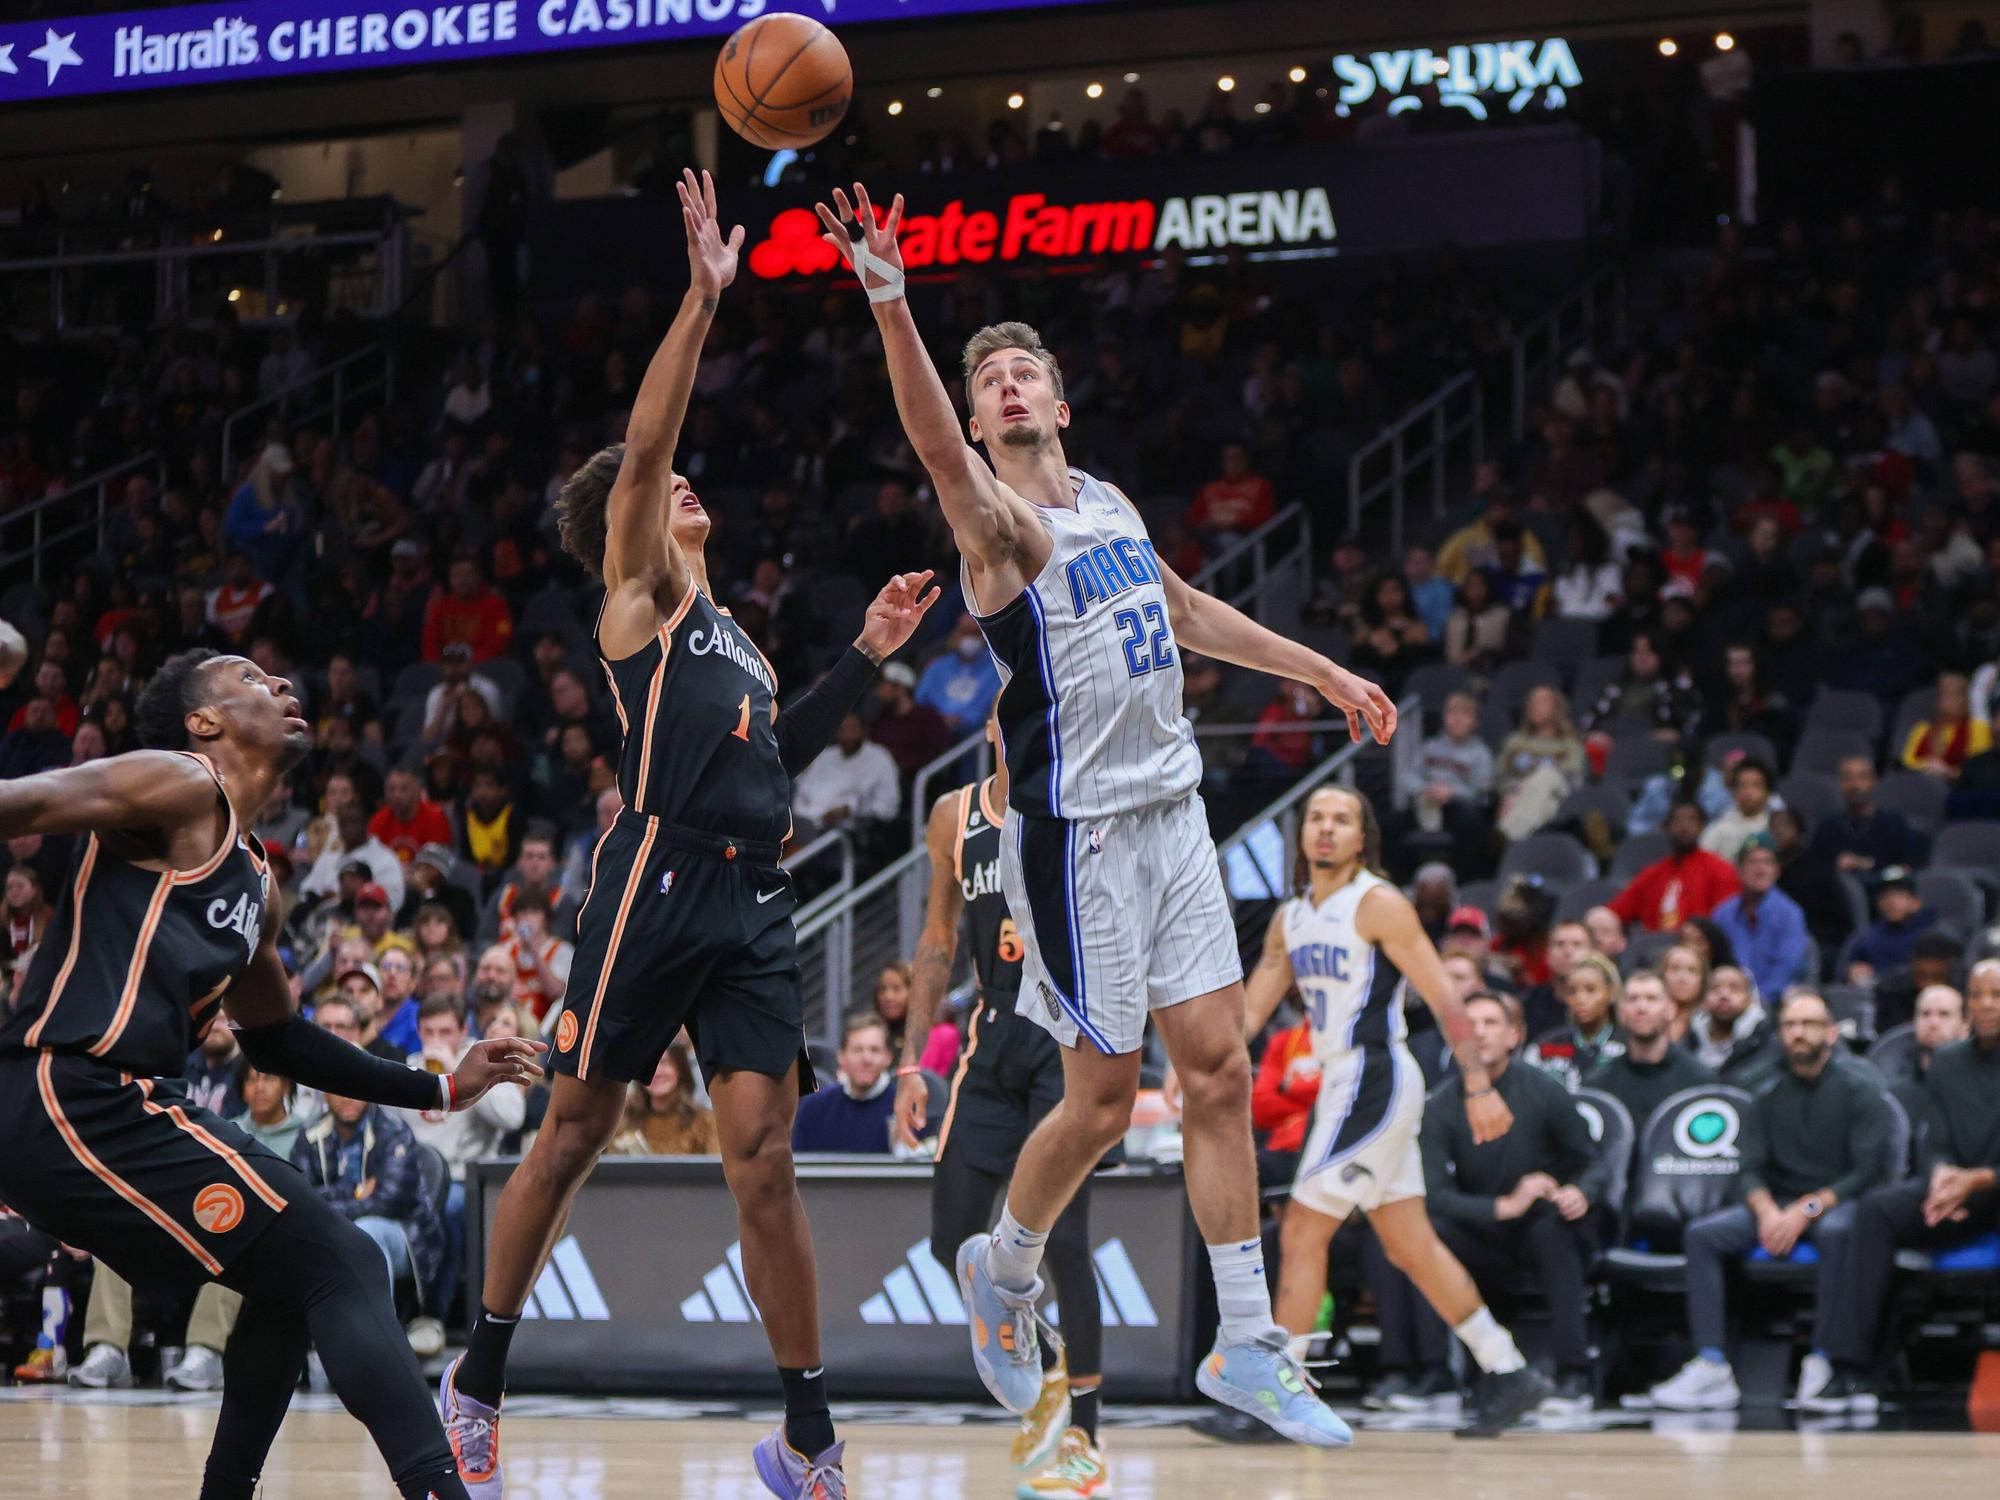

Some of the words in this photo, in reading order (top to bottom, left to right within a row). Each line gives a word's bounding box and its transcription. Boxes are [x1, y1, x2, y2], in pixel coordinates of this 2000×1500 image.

[267, 0, 517, 62] CHEROKEE
[841, 200, 999, 269] ate
[1000, 193, 1156, 261] Farm
[1154, 187, 1337, 251] ARENA
[1114, 601, 1174, 678] 22
[731, 693, 751, 741] 1
[969, 810, 981, 826] 6
[962, 858, 1001, 901] Atl
